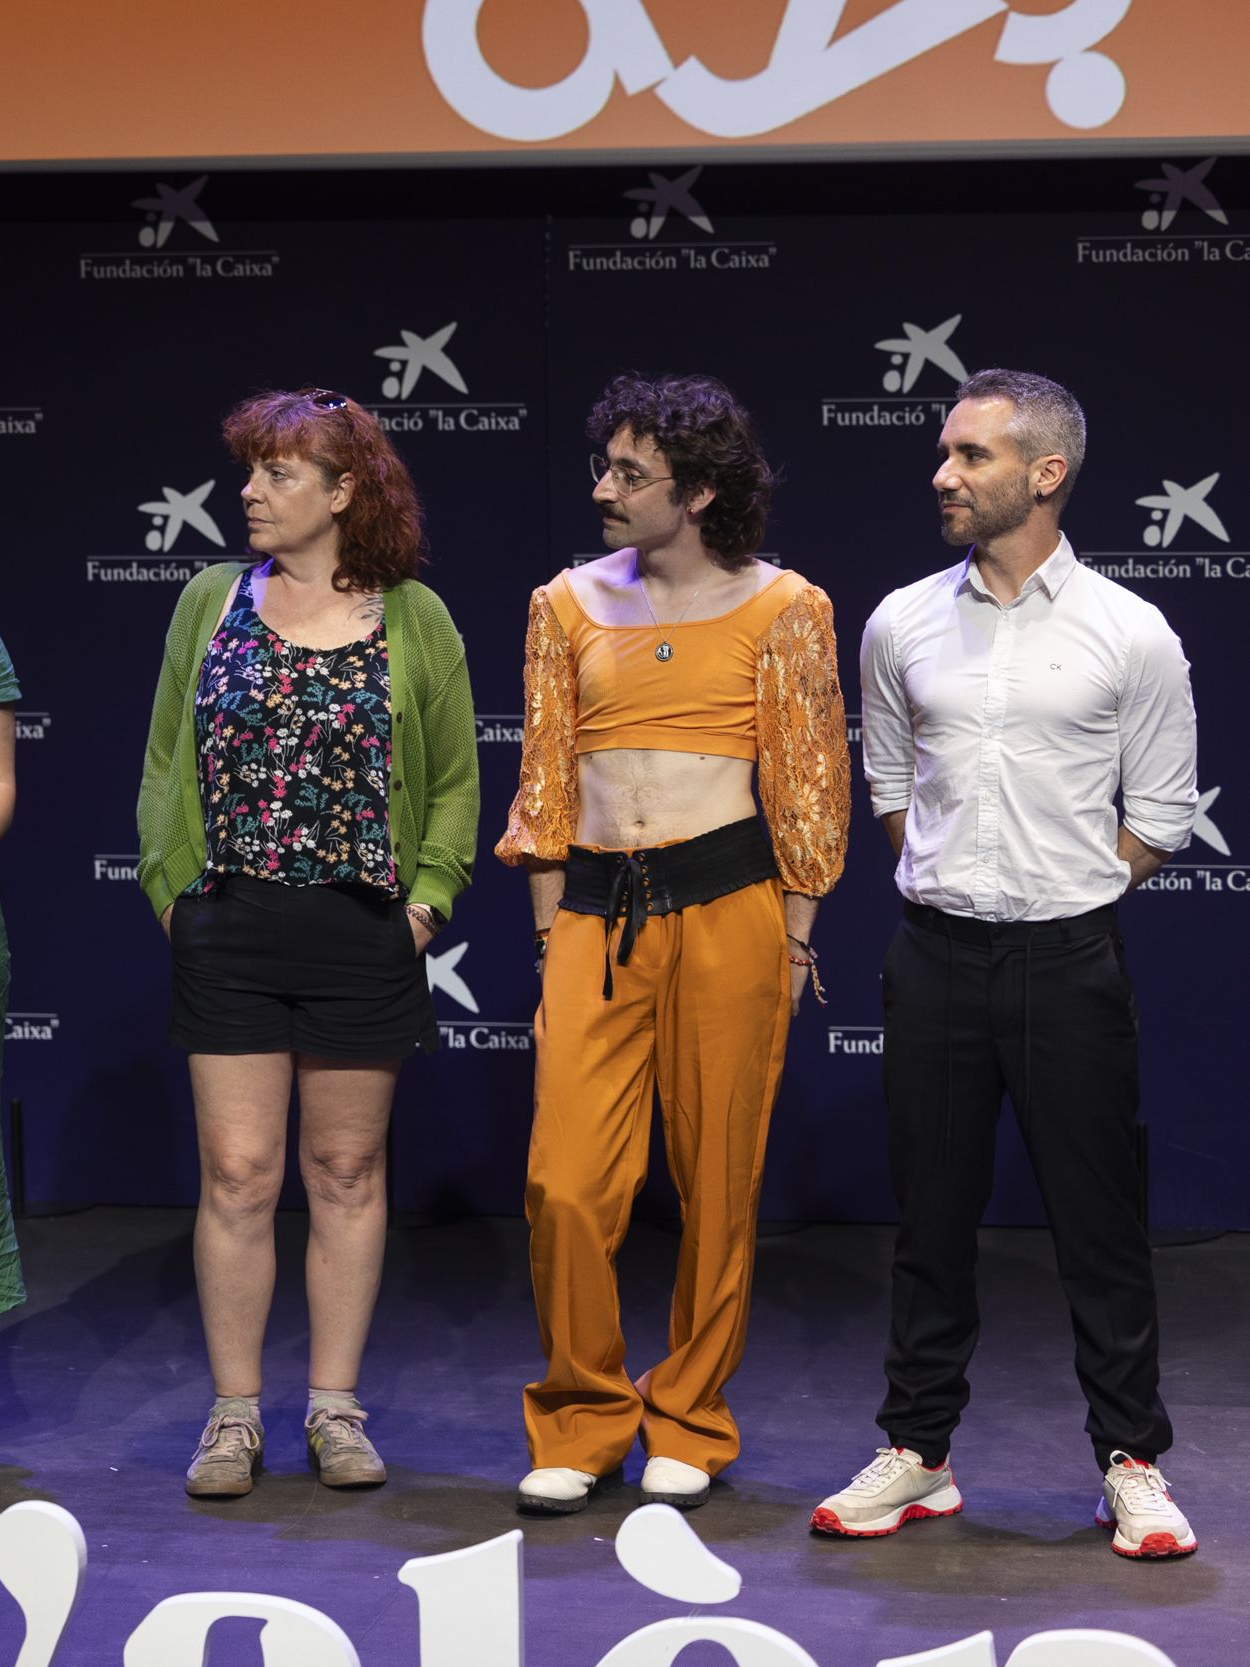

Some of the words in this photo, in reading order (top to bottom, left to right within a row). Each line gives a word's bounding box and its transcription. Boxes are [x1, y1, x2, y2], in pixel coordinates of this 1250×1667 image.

[568, 250, 677, 271] Fundación
[1077, 241, 1190, 263] Fundación
[80, 259, 184, 279] Fundación
[822, 404, 925, 426] Fundació
[86, 561, 190, 582] Fundación
